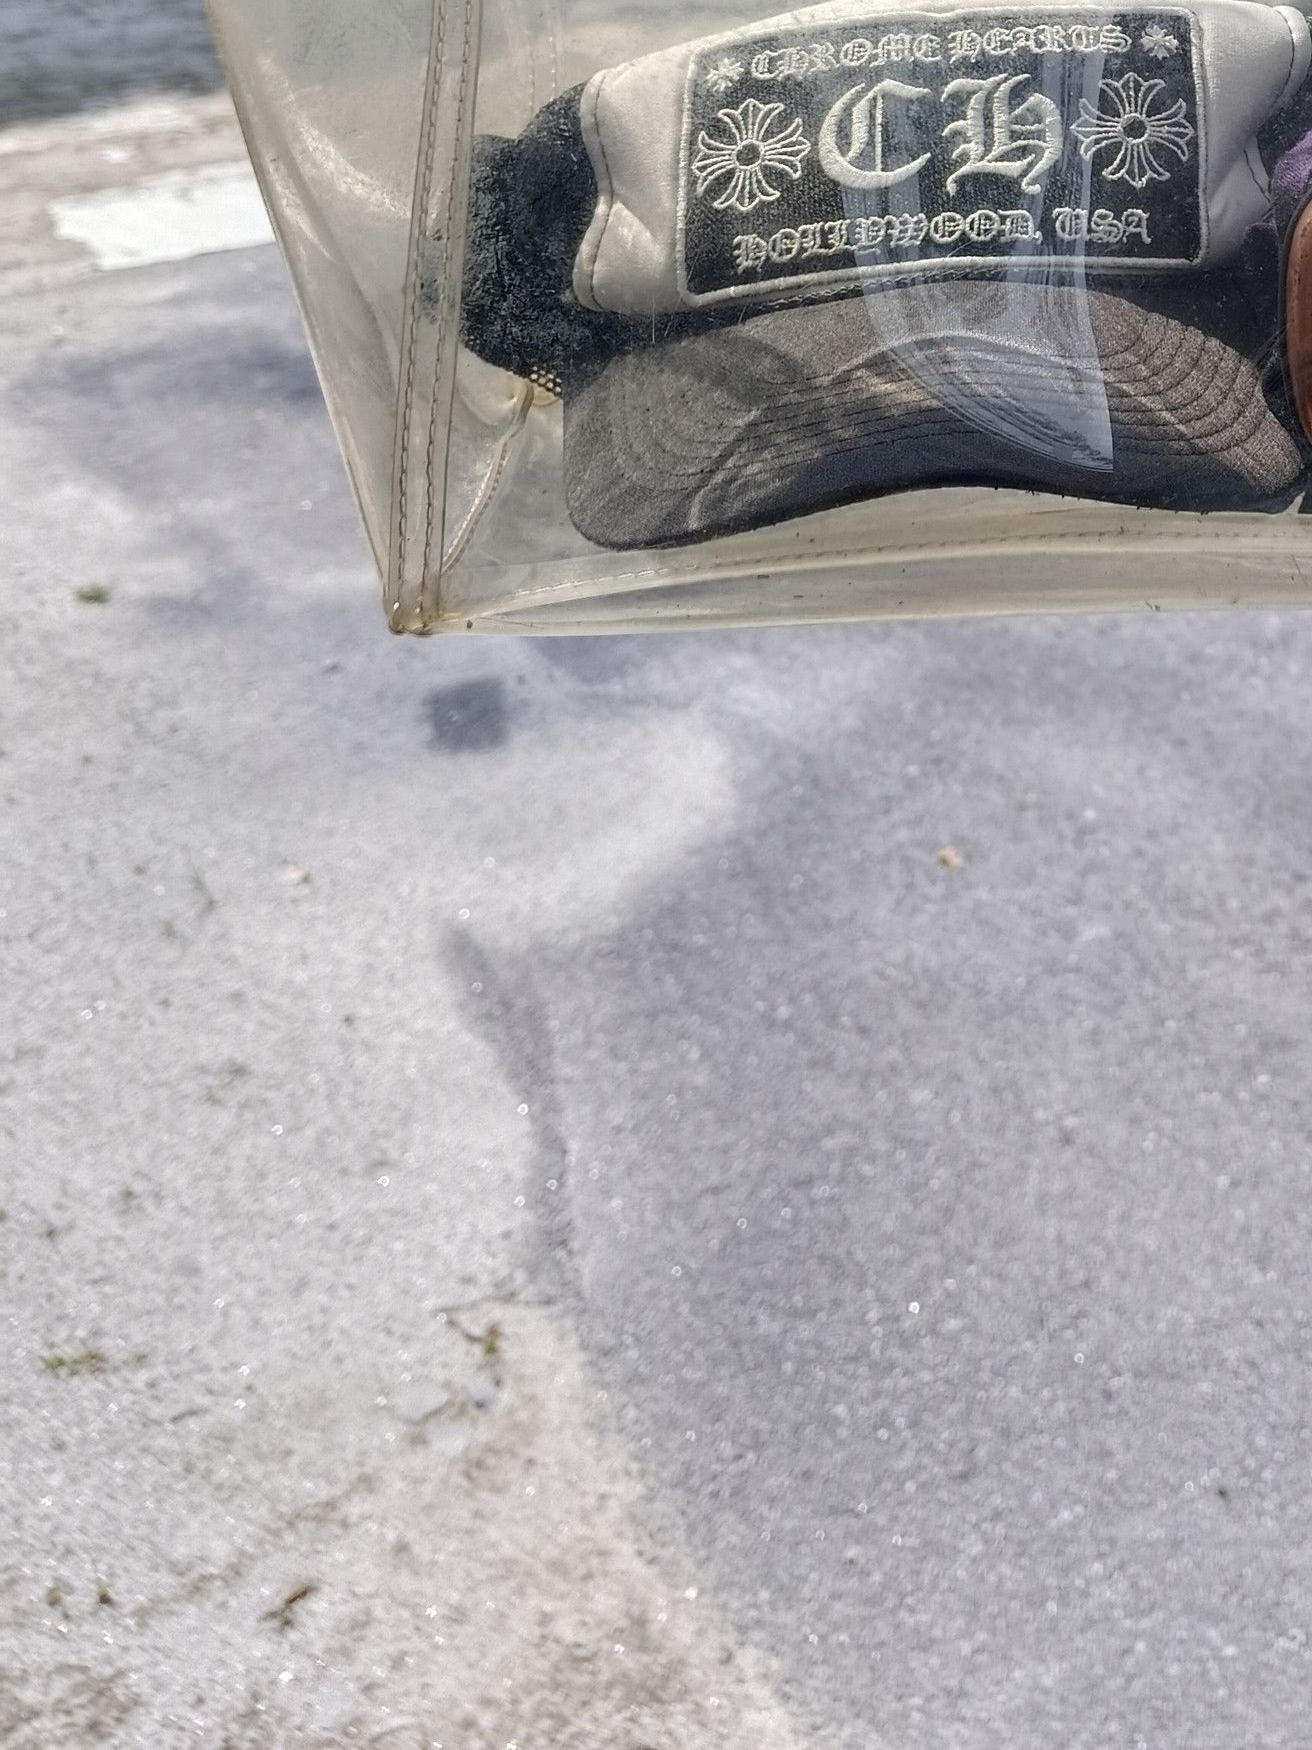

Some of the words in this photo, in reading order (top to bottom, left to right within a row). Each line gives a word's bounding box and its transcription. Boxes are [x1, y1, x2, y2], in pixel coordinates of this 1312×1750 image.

[751, 33, 942, 81] CHROME
[948, 24, 1133, 64] HEARTS
[1052, 207, 1152, 244] USA
